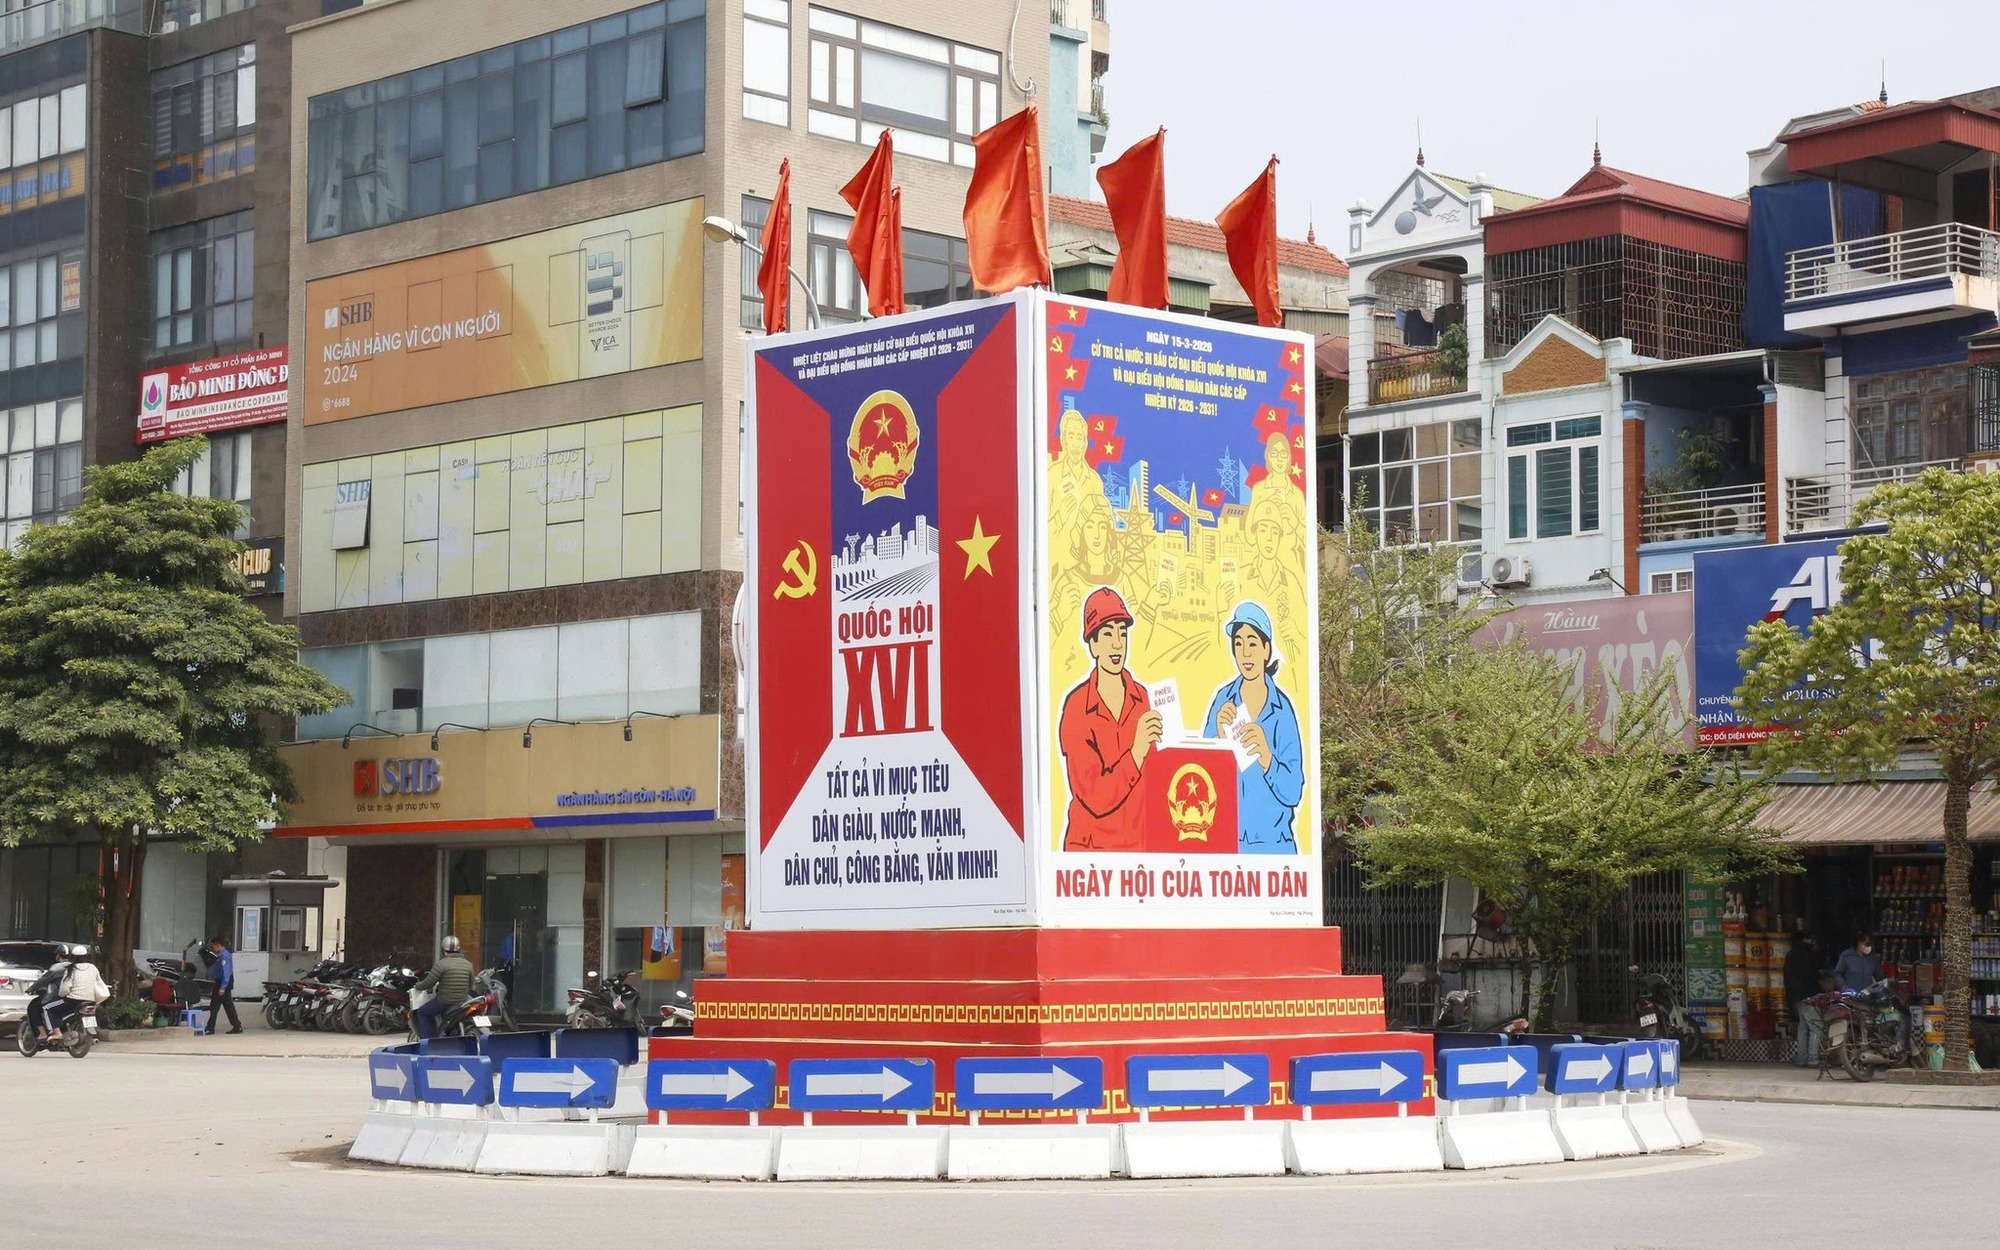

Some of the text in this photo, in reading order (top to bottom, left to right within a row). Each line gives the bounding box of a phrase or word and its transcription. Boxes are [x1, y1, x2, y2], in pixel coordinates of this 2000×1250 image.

[341, 302, 373, 326] SHB
[323, 310, 500, 362] NGÂN HÀNG VÌ CON NGƯỜI
[793, 324, 975, 367] NHIỆT LIỆT CHÀO MỪNG NGÀY BẦU CỬ ĐẠI BIỂU QUỐC HỘI KHÓA XVI
[1146, 331, 1213, 353] NGÀY 15-3-2026
[222, 360, 230, 369] TY
[324, 364, 358, 385] 2024
[798, 367, 806, 380] VÀ
[806, 367, 816, 379] ĐẠI
[817, 362, 830, 376] BIỂU
[830, 362, 840, 376] HỘI
[841, 359, 856, 373] ĐỒNG
[857, 356, 873, 369] NHÂN
[873, 354, 885, 367] DÂN
[886, 350, 897, 364] CÁC
[898, 348, 909, 362] CẤP
[910, 346, 929, 360] NHIỆM
[929, 344, 938, 356] KỲ
[956, 339, 973, 351] 2031!
[1091, 339, 1267, 383] CỬ TRI CẢ NƯỚC ĐI BẦU CỬ ĐẠI BIỂU QUỐC HỘI KHÓA XVI
[169, 376, 197, 402] BẢO
[198, 373, 236, 397] MINH
[237, 365, 278, 390] ĐÔNG
[1113, 366, 1247, 400] VÀ ĐẠI BIỂU HỘI ĐỒNG NHÂN DÂN CÁC CẤP
[208, 401, 246, 414] INSURANCE
[248, 394, 288, 407] CORPORATI
[1144, 393, 1167, 410] NHIỆM
[1167, 394, 1177, 410] KỲ
[1178, 399, 1194, 413] 2026
[1199, 402, 1217, 416] 2031!
[452, 458, 468, 468] CASH
[338, 482, 370, 504] SHB
[244, 548, 271, 576] CLUB
[838, 600, 933, 644] QUỐC HỘI
[1543, 607, 1600, 630] Hằng
[839, 640, 934, 738] XVI
[1700, 711, 1733, 726] NHẬN
[1714, 731, 1727, 742] ĐỐI
[1728, 731, 1745, 742] DIỆN
[381, 757, 442, 796] SHB
[827, 757, 950, 801] TẤT CẢ VÌ MỤC TIÊU
[633, 787, 656, 803] GÒN
[676, 785, 696, 806] NỘI
[812, 801, 966, 843] DÂN GIÀU, NƯỚC MẠNH,
[784, 841, 998, 888] DÂN CHỦ, CÔNG BẰNG, VĂN MINH!
[1056, 858, 1307, 904] NGÀY HỘI CỦA TOÀN DÂN
